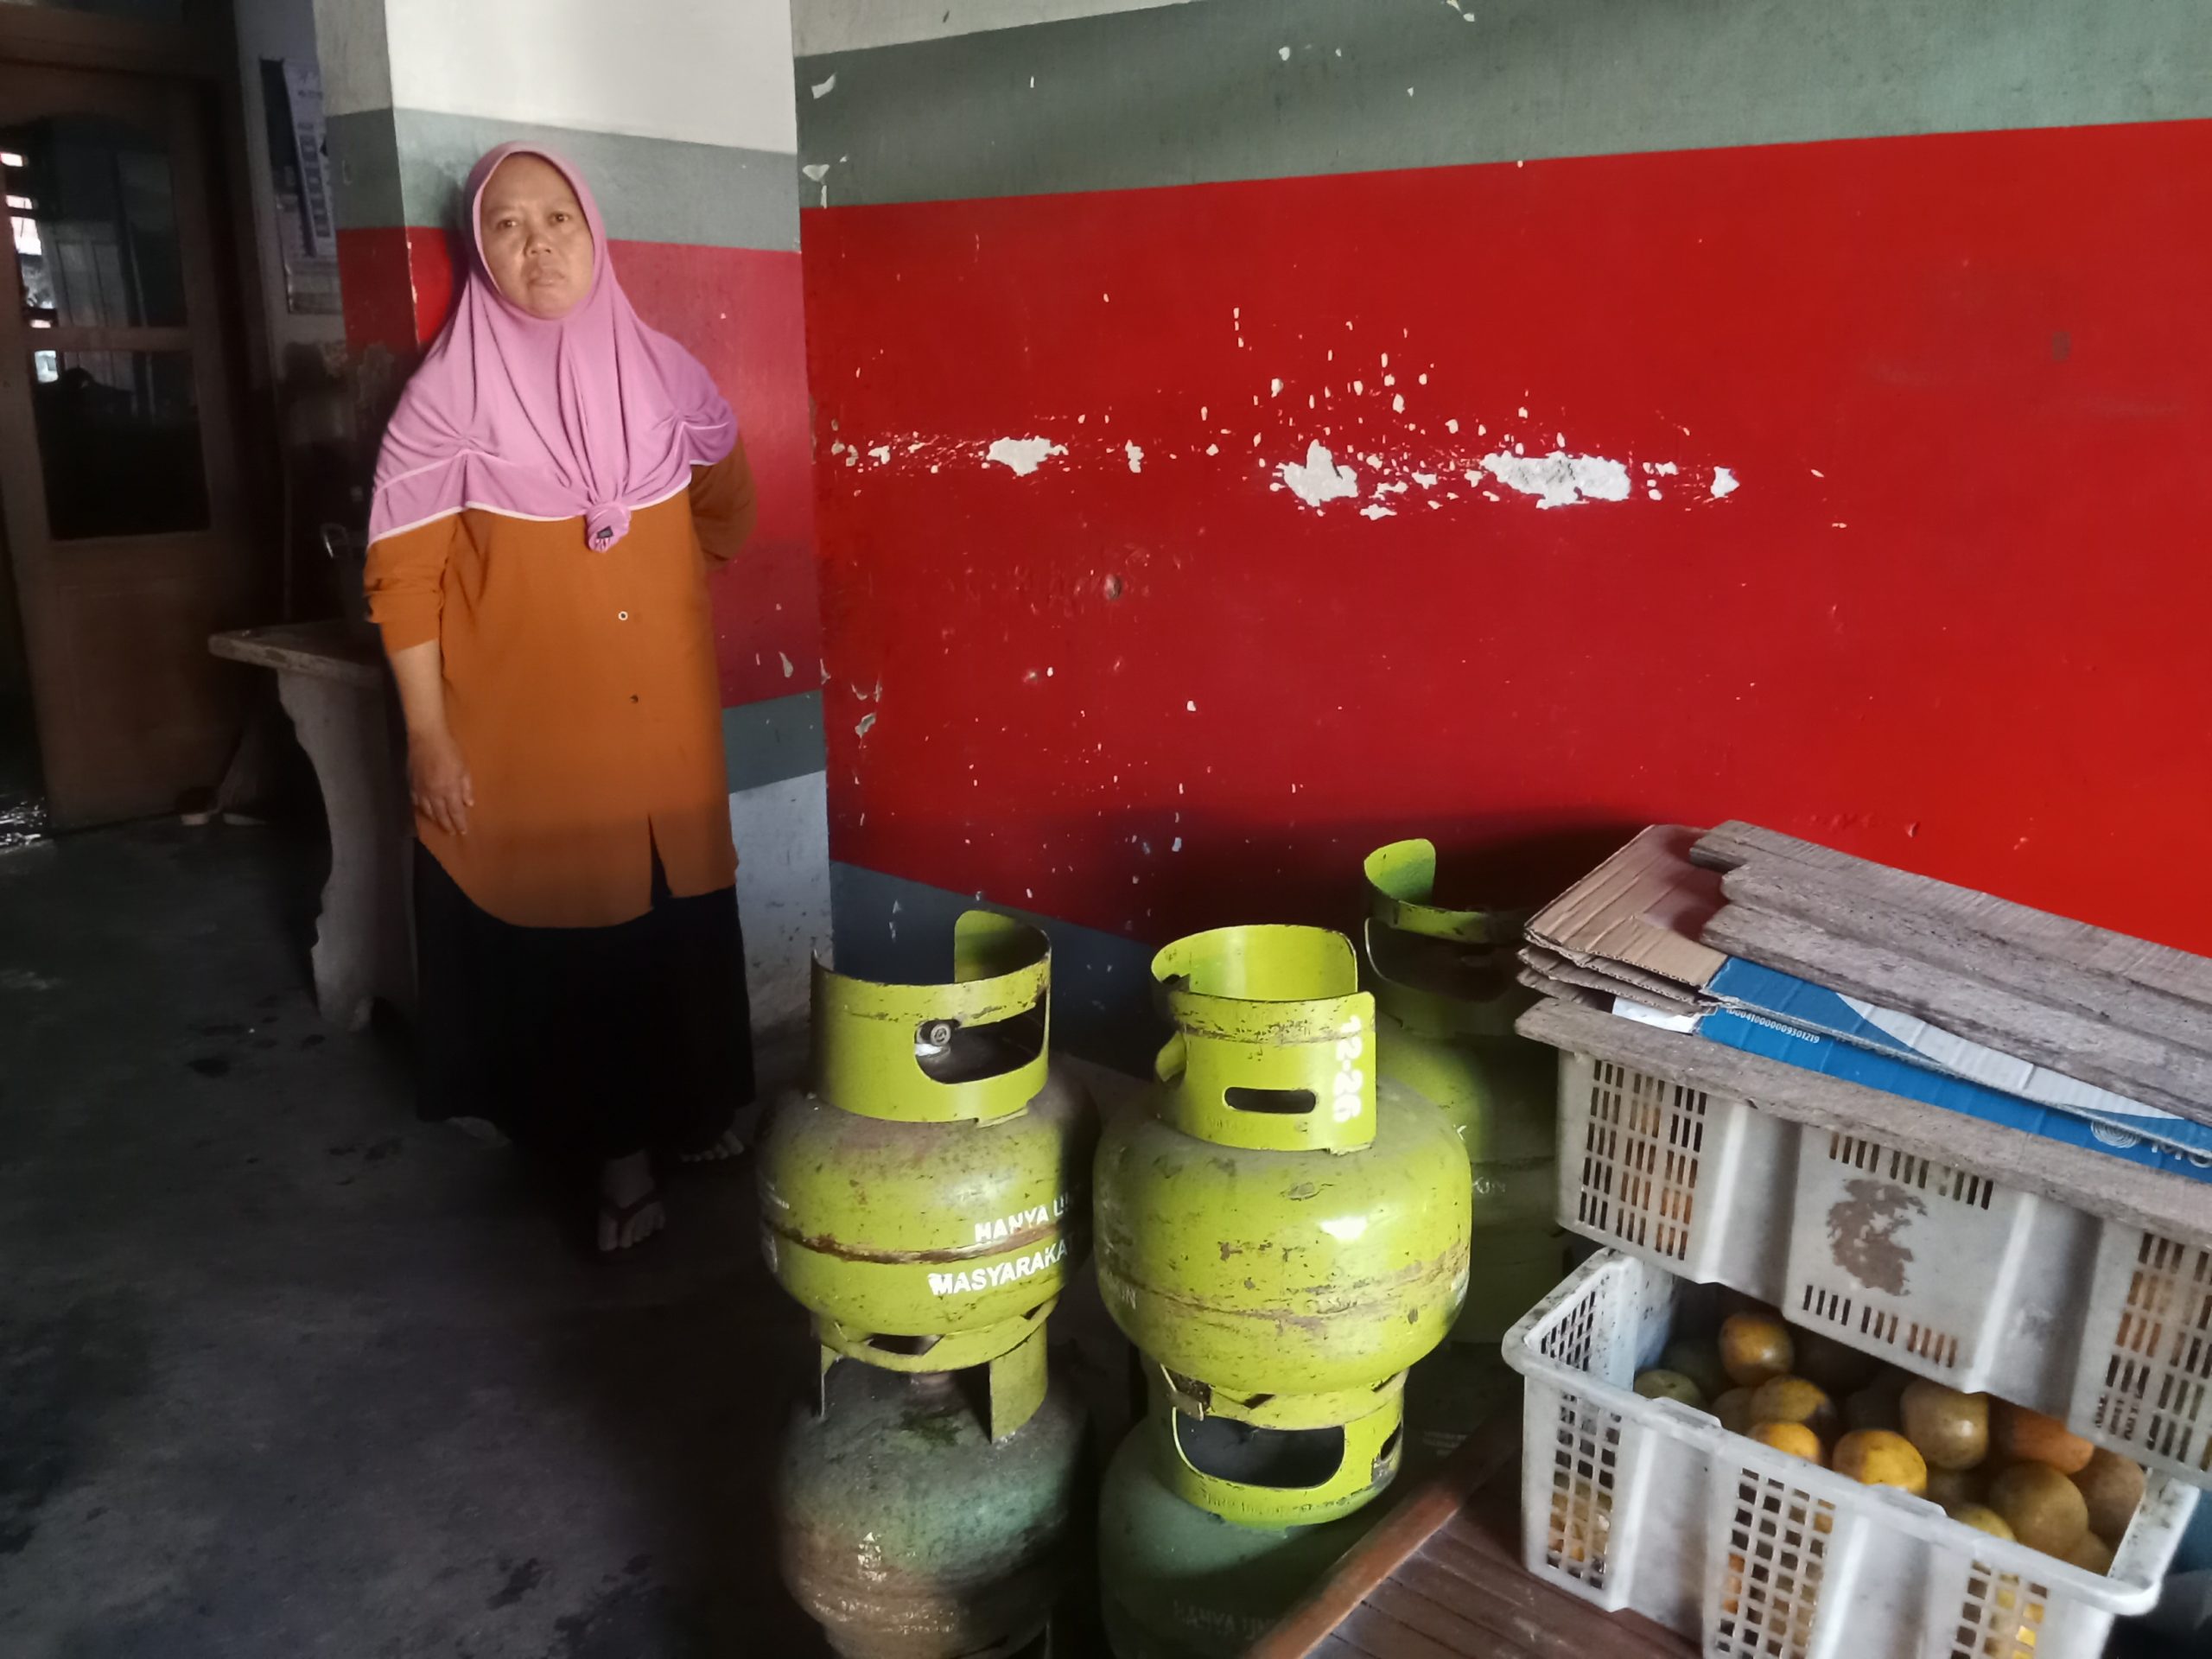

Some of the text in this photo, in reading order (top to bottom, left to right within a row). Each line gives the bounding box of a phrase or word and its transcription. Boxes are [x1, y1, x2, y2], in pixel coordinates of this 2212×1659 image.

[1334, 1014, 1363, 1122] 12-26
[974, 1205, 1049, 1243] HANYA
[928, 1236, 1072, 1295] MASYARAKA
